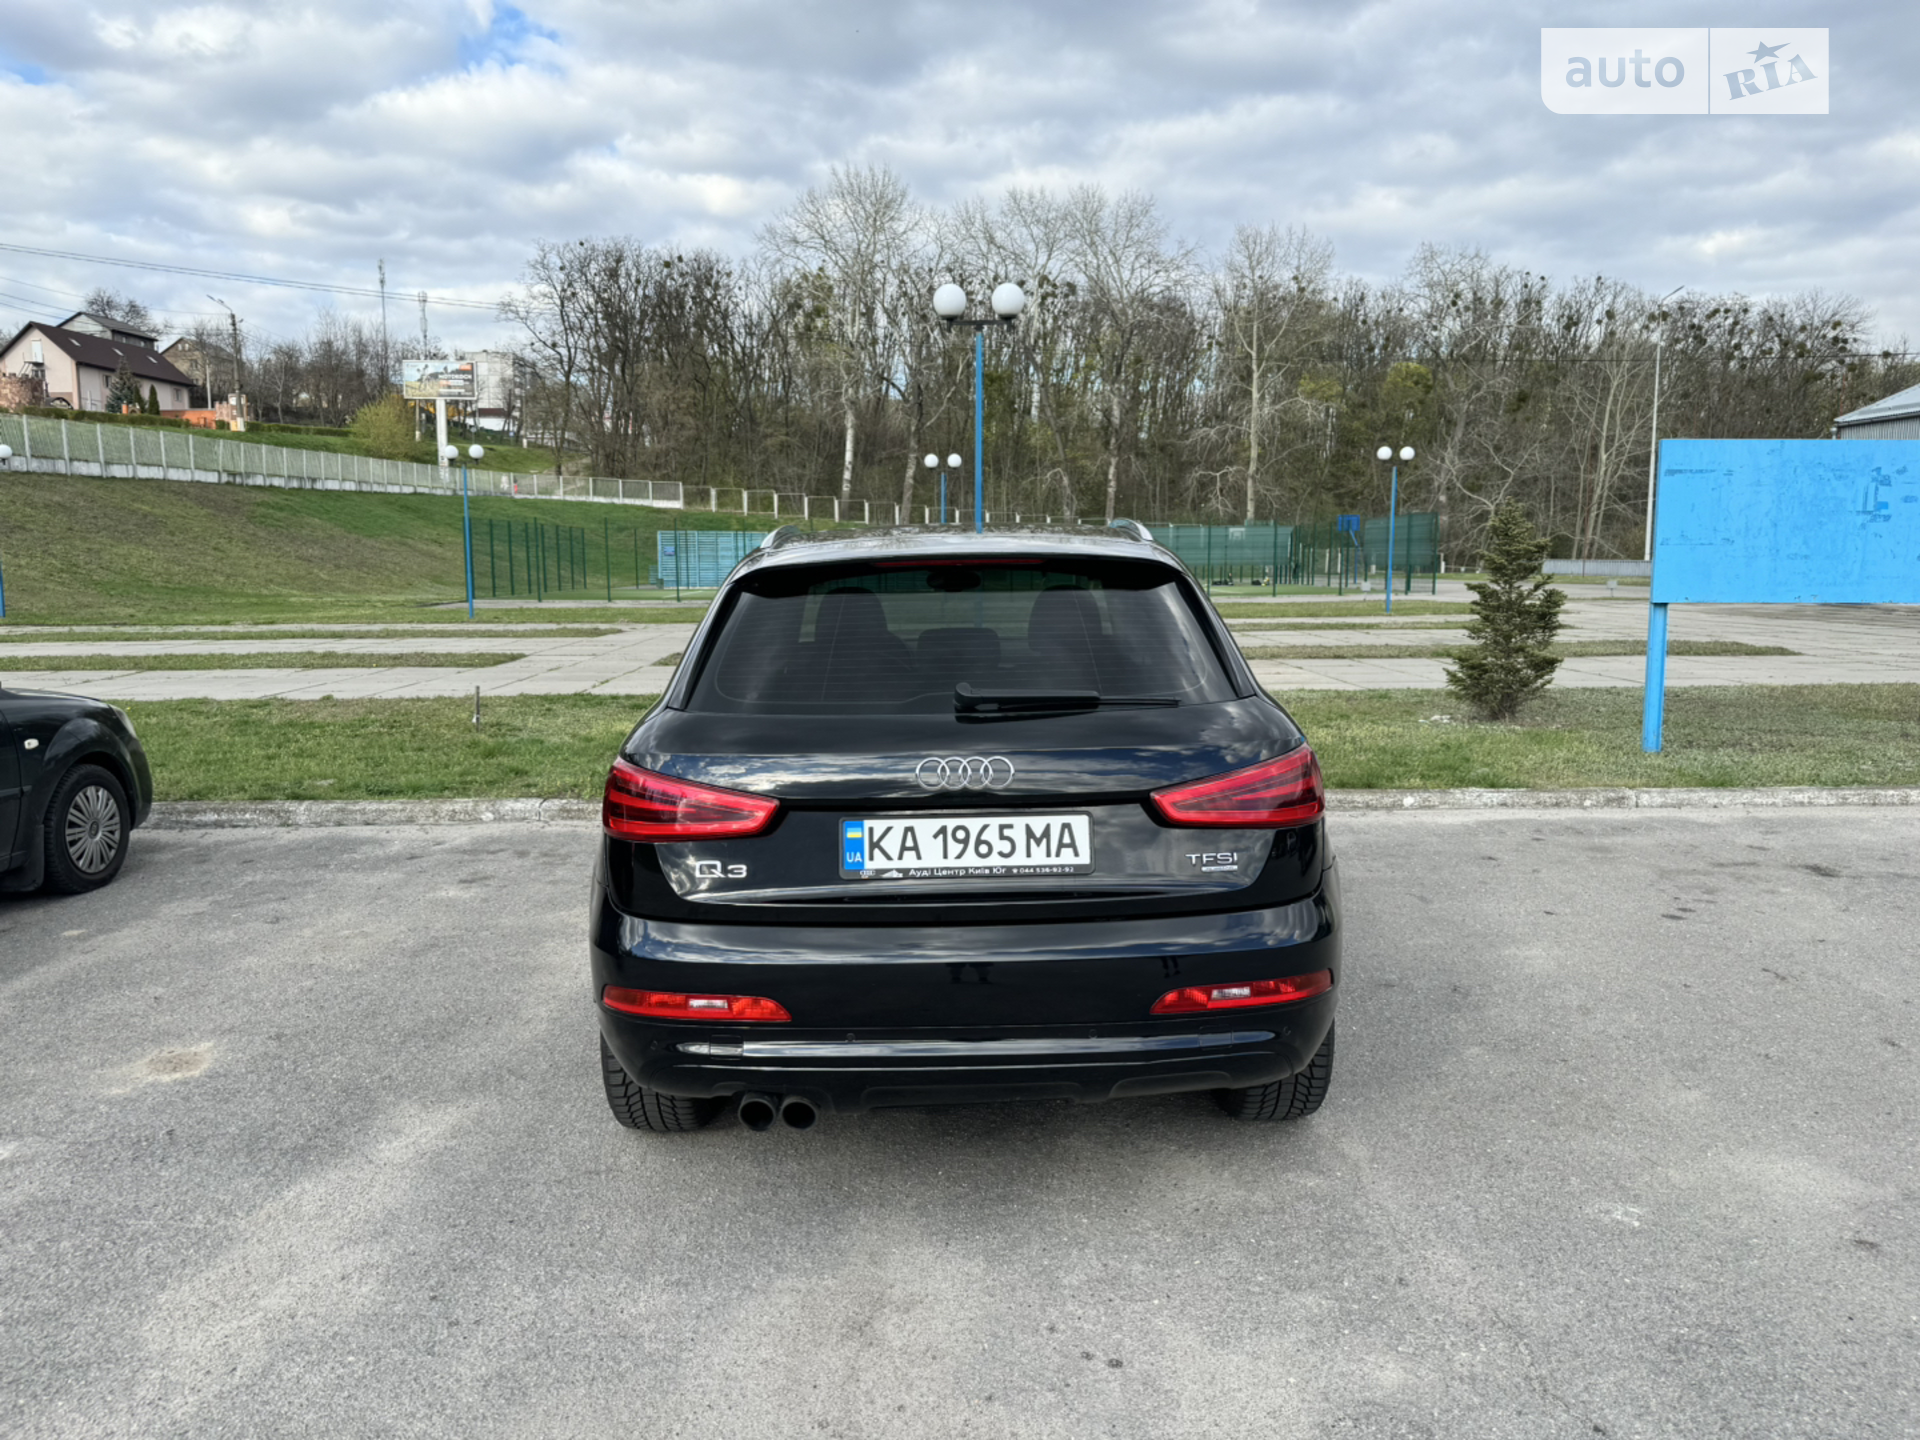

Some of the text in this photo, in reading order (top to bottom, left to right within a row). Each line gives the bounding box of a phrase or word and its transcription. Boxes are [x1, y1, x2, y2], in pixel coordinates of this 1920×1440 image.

[868, 822, 1080, 862] KA 1965 MA
[846, 852, 863, 863] UA
[1185, 852, 1238, 865] TFSI
[695, 860, 748, 878] Q3
[908, 868, 932, 878] Ауді
[934, 867, 966, 877] Центр
[968, 867, 990, 875] Київ
[992, 865, 1007, 874] Юг
